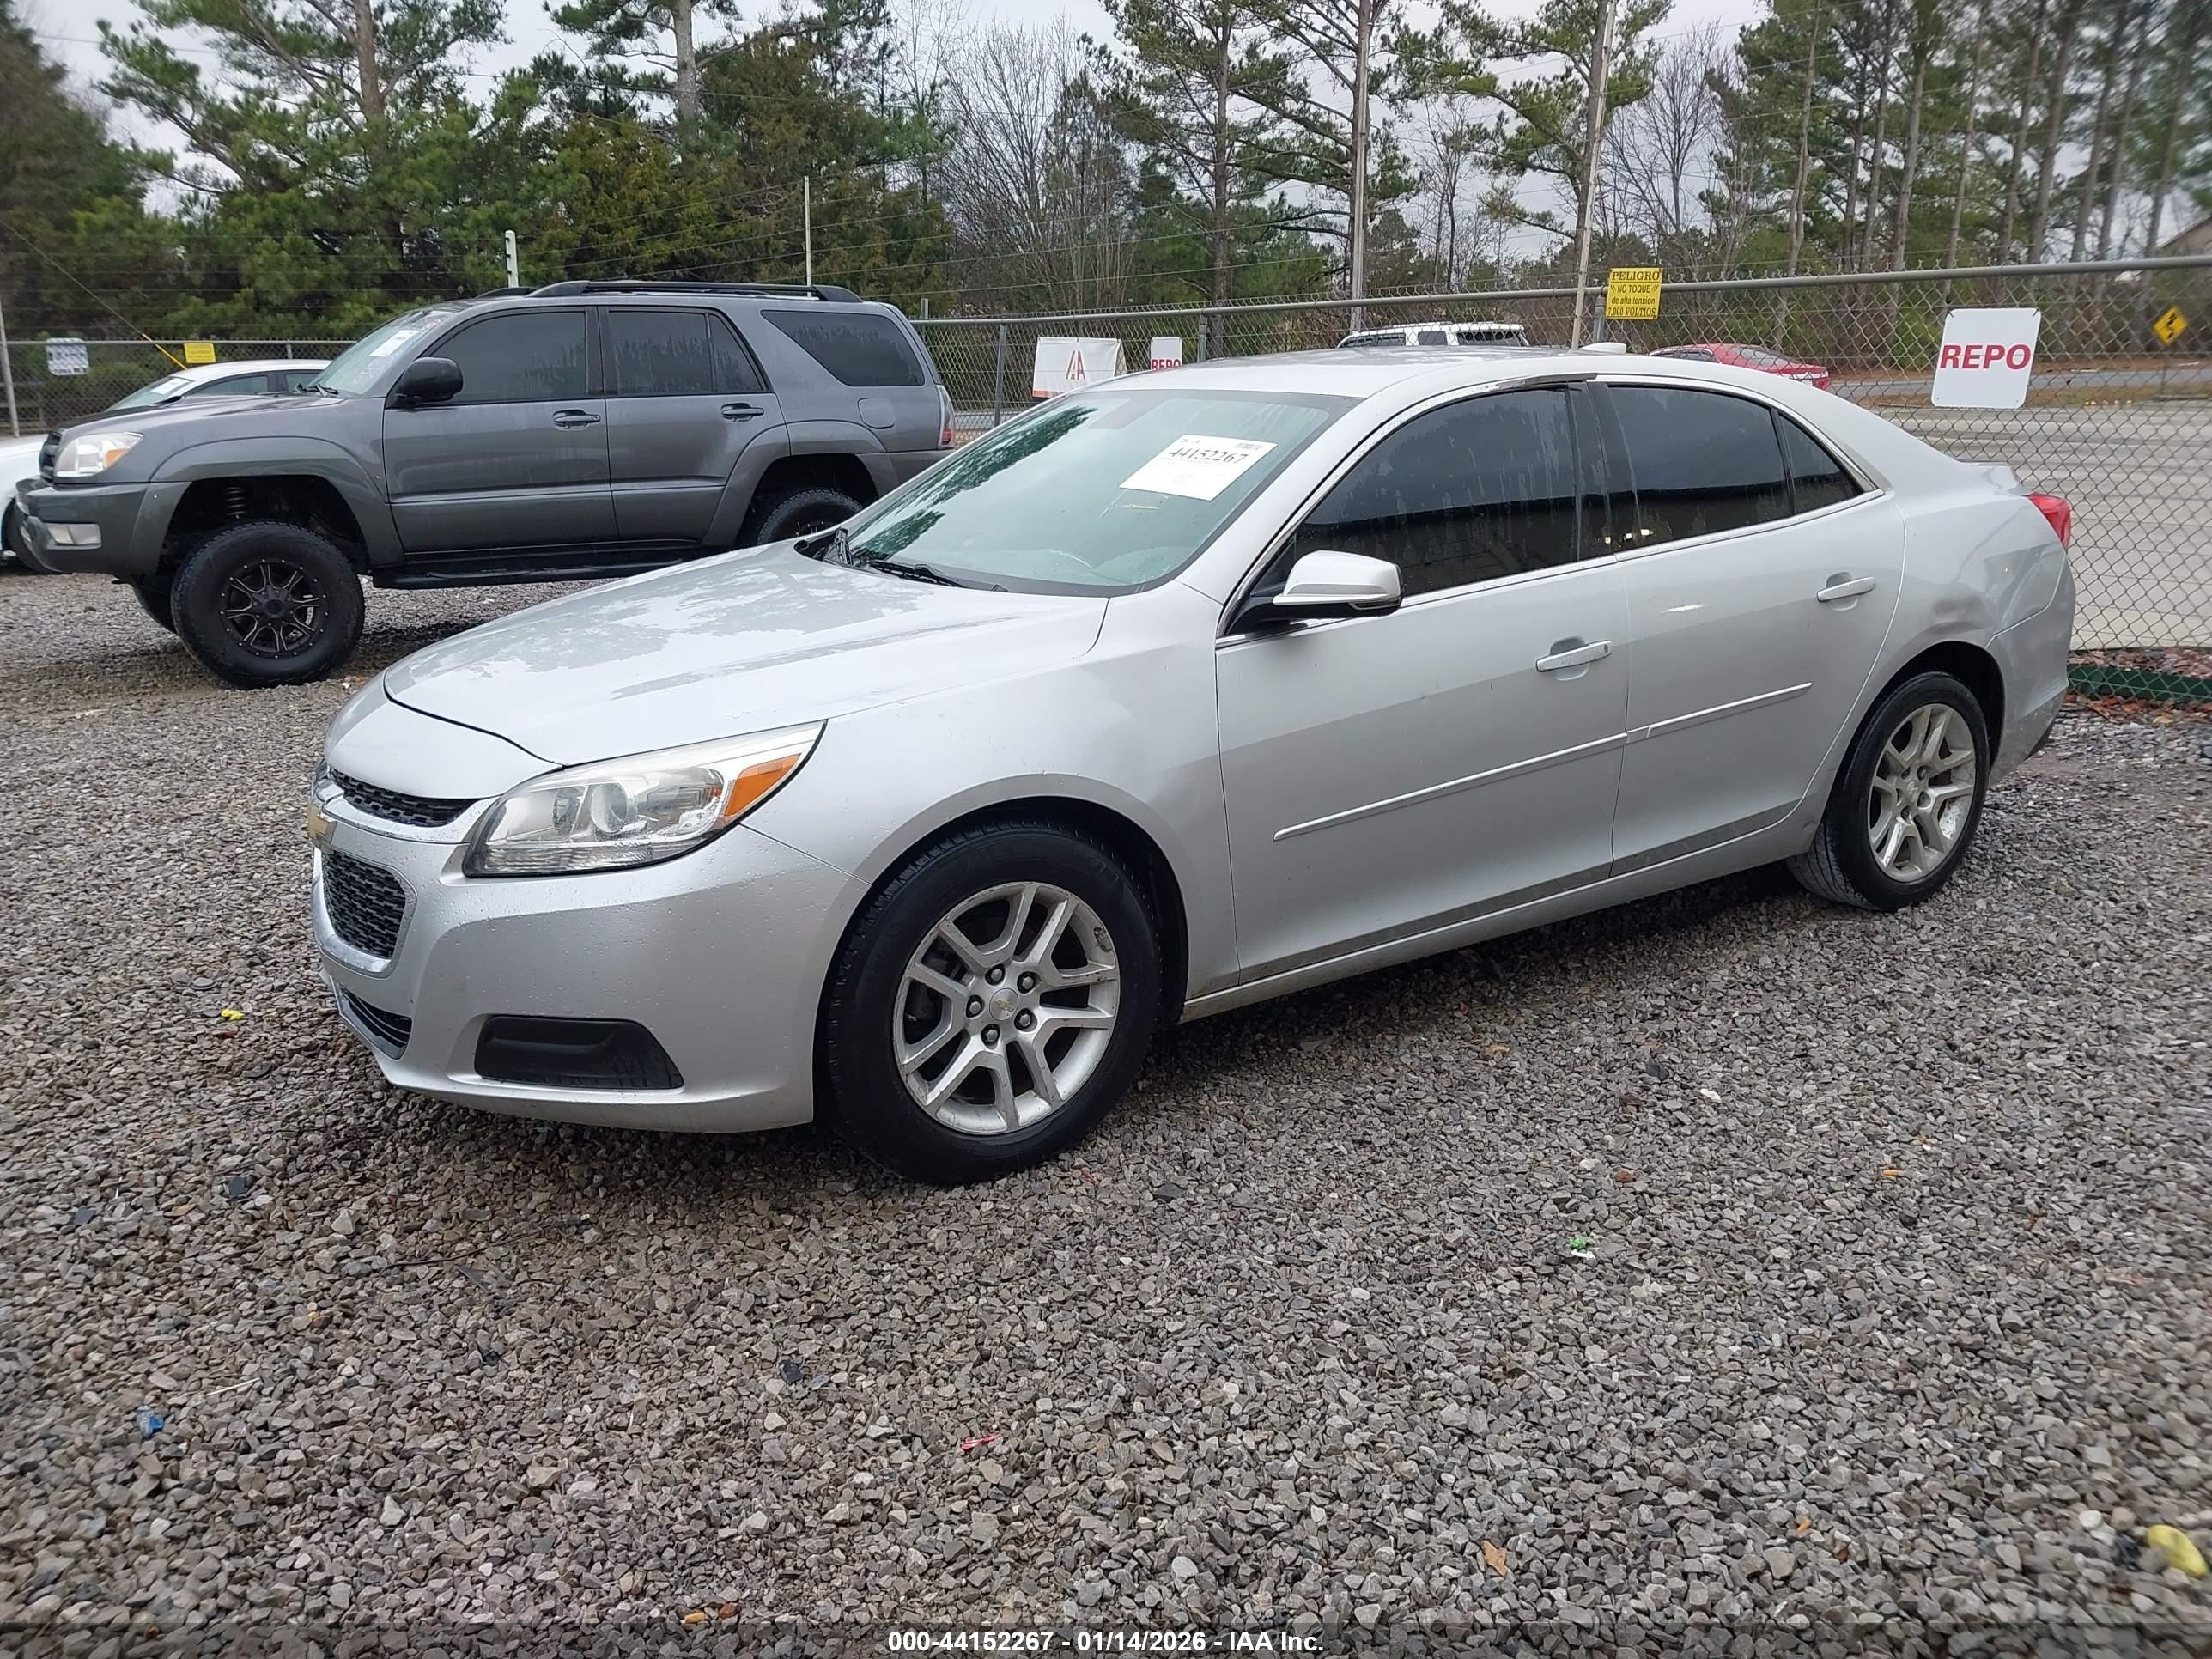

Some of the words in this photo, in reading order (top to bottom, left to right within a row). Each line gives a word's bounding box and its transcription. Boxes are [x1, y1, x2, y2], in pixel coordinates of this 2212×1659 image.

[1612, 270, 1660, 281] PELIGRO
[1617, 284, 1627, 293] NO
[1628, 284, 1651, 294] TOQUE
[1620, 296, 1632, 305] alta
[1625, 307, 1656, 317] VOLTIOS
[1939, 343, 2032, 370] REPO
[1170, 447, 1249, 464] 44152267
